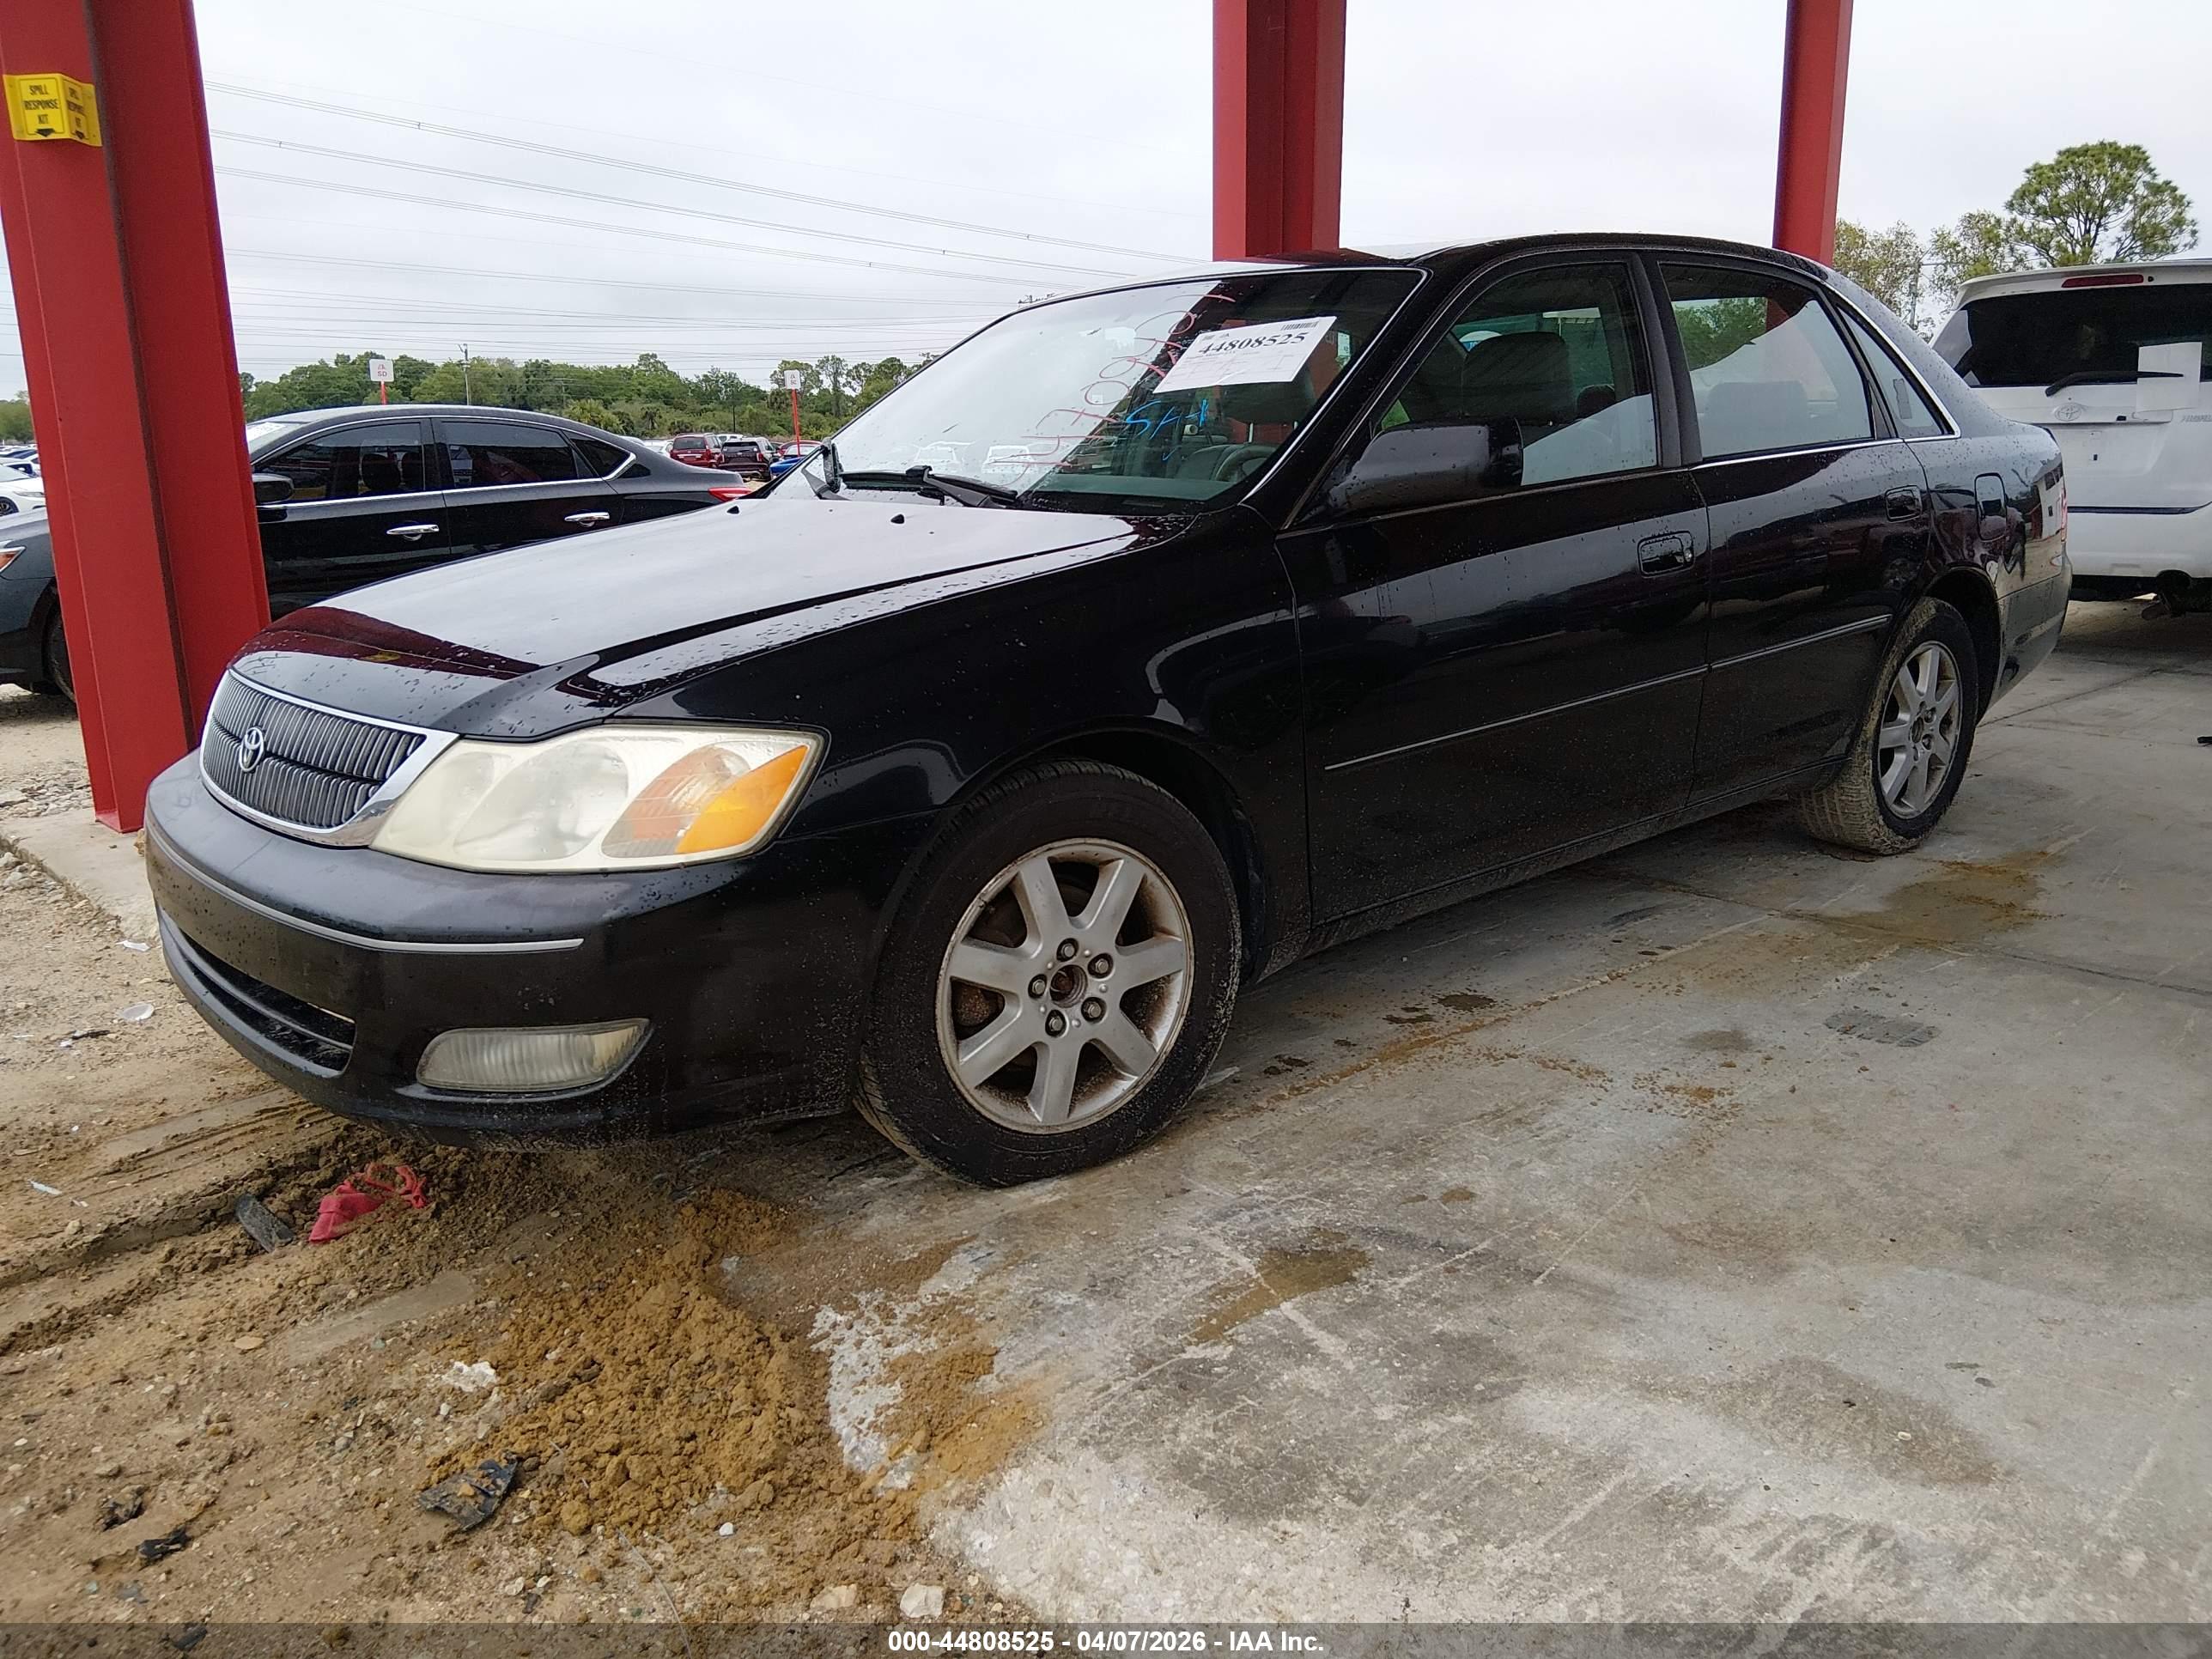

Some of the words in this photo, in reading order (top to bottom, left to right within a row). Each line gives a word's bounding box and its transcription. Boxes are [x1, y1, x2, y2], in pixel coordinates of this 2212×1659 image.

[29, 84, 48, 95] SPILL
[23, 99, 59, 110] RESPONSE
[38, 114, 48, 125] KIT
[1199, 331, 1310, 355] 44808525
